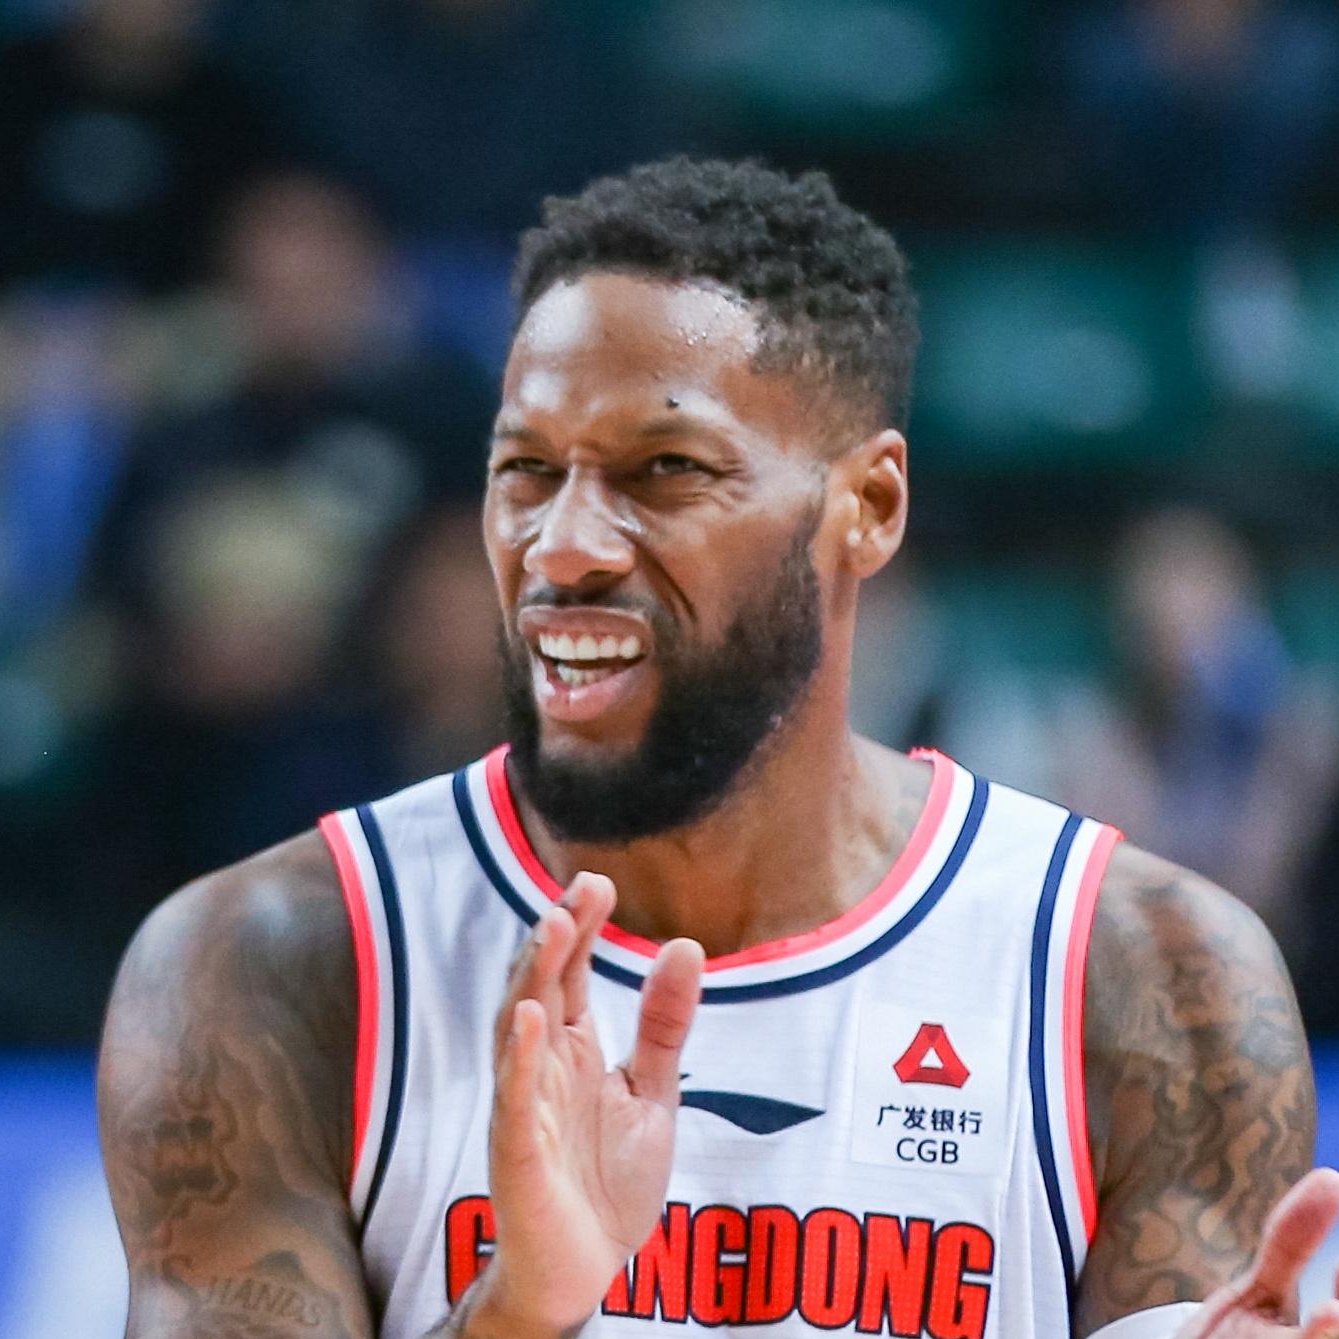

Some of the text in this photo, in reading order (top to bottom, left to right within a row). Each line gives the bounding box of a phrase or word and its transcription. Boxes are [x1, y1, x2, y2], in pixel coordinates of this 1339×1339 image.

[876, 1103, 983, 1134] 广发银行
[896, 1137, 959, 1164] CGB
